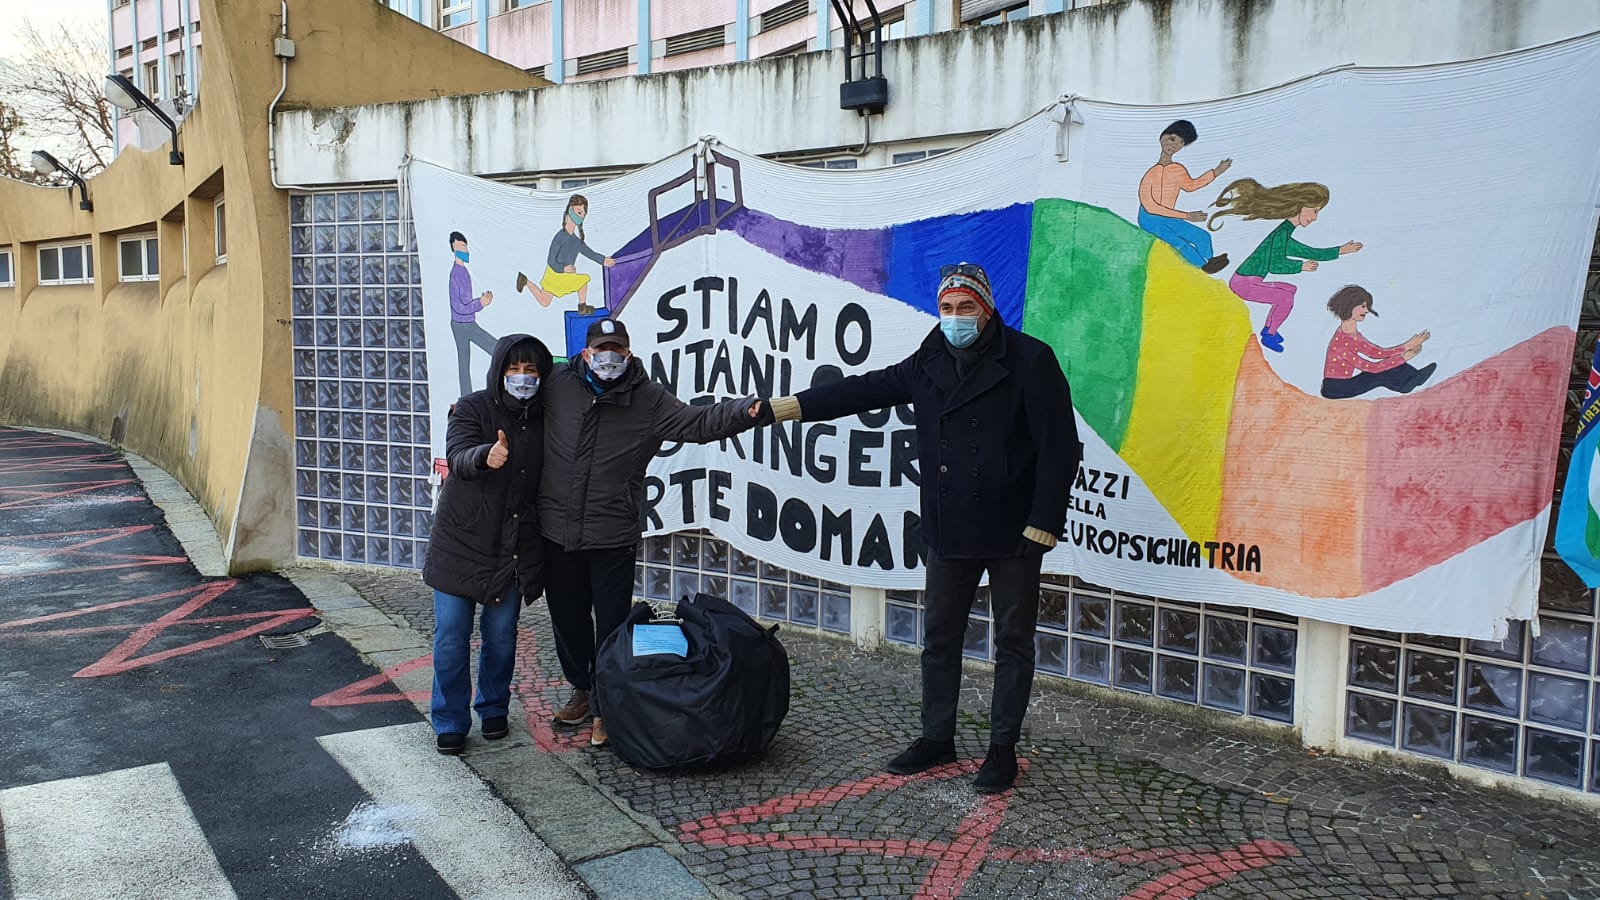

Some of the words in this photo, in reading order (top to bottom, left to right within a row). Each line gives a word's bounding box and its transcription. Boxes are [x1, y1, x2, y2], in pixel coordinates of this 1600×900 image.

[651, 339, 791, 399] NTANI
[1068, 495, 1107, 521] ELLA
[1074, 466, 1130, 500] AZZI
[641, 467, 732, 532] RTE
[746, 482, 928, 570] DOMAN
[1058, 520, 1261, 573] EUROPSICHIATRIA
